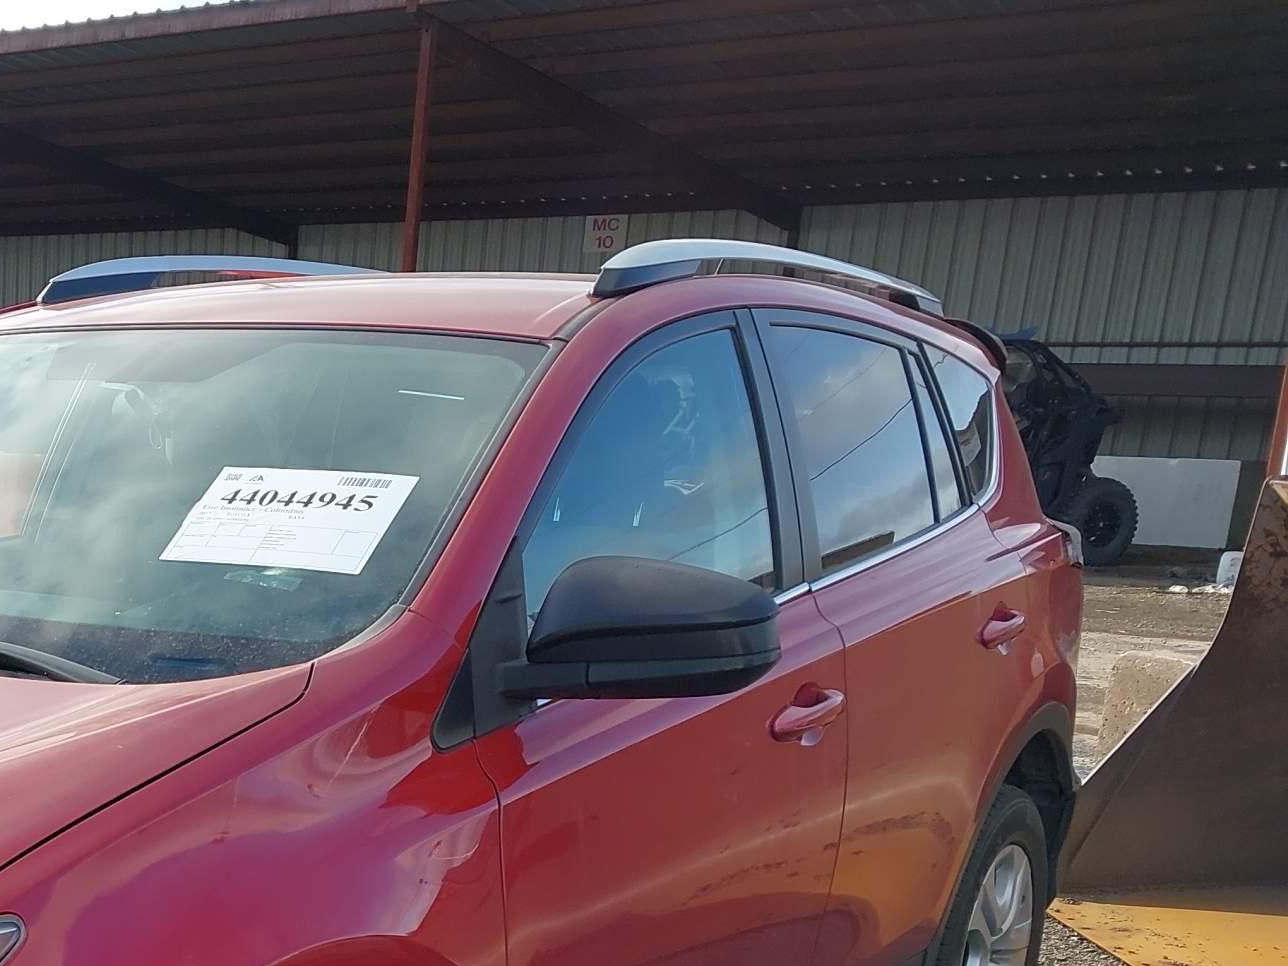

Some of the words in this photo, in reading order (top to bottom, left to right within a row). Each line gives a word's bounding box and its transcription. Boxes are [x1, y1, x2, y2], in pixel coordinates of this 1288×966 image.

[593, 218, 619, 231] MC
[596, 235, 614, 249] 10
[220, 488, 379, 512] 44044945
